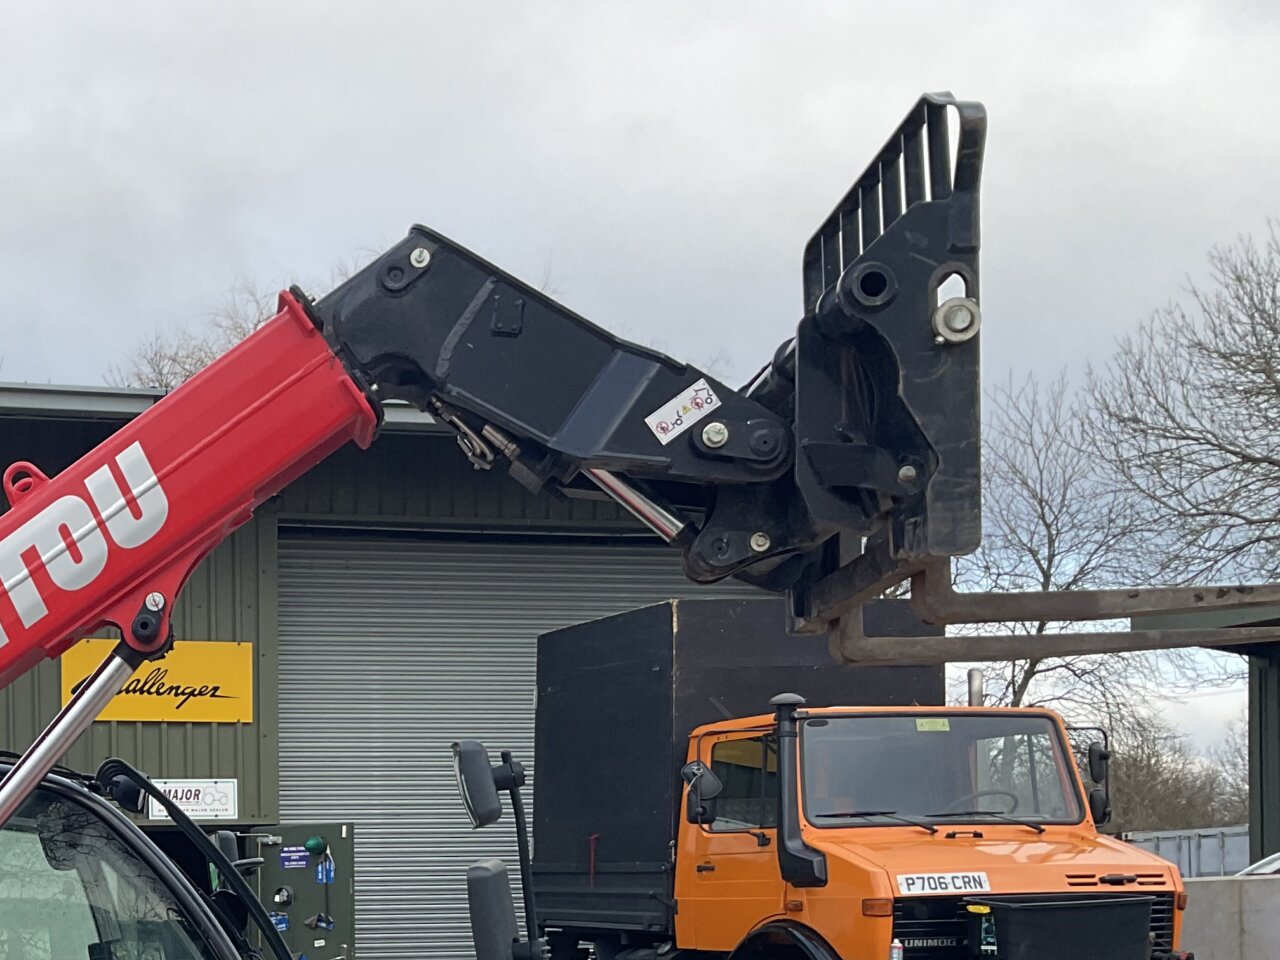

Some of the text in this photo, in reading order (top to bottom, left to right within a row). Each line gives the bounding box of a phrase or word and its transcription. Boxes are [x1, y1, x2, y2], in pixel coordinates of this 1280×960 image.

[71, 667, 240, 710] allenger
[163, 789, 202, 800] MAJOR
[905, 874, 984, 891] P706 CRN
[904, 938, 957, 948] UNIMOG
